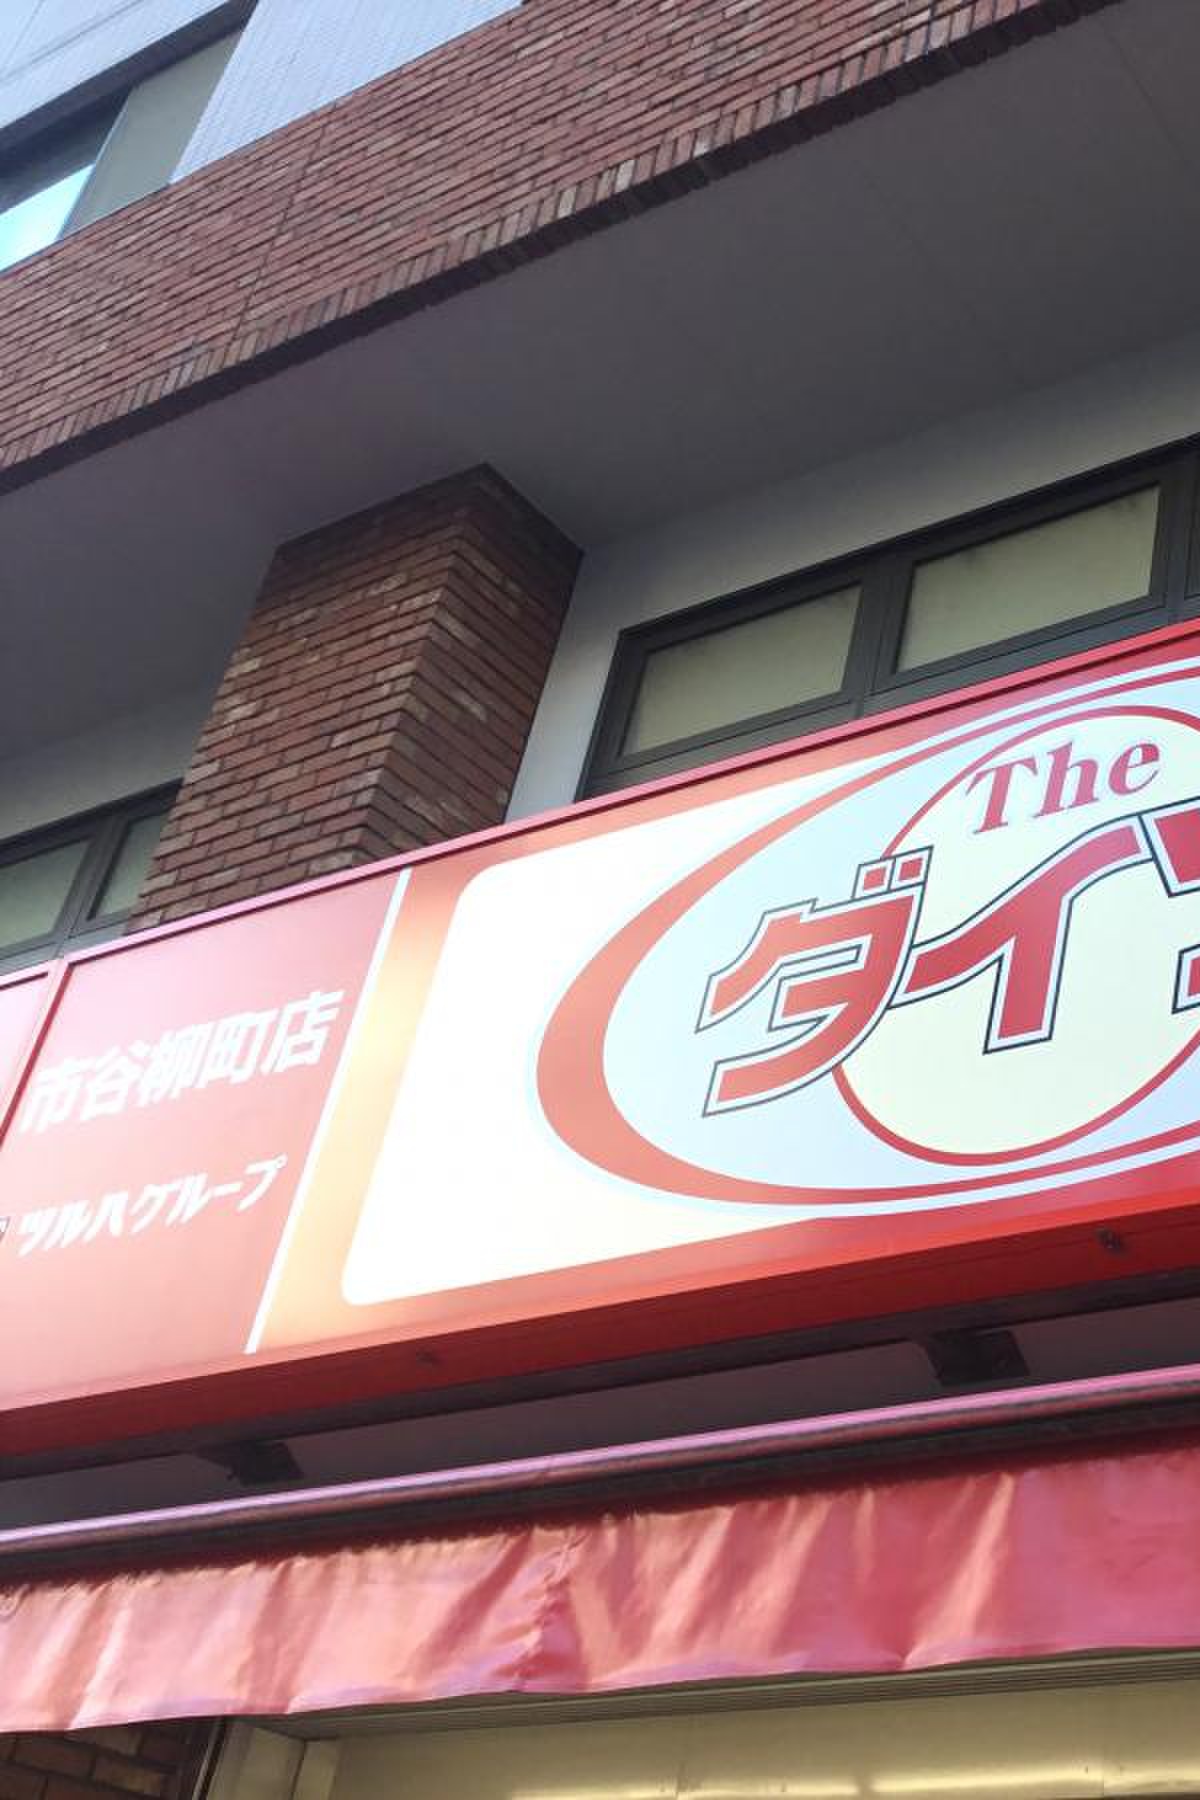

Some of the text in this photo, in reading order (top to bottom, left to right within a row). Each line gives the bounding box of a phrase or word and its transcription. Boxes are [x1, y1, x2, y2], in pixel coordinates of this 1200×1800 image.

[966, 737, 1161, 835] The
[20, 989, 345, 1133] 市谷柳町店
[17, 1153, 288, 1257] ツルハグループ
